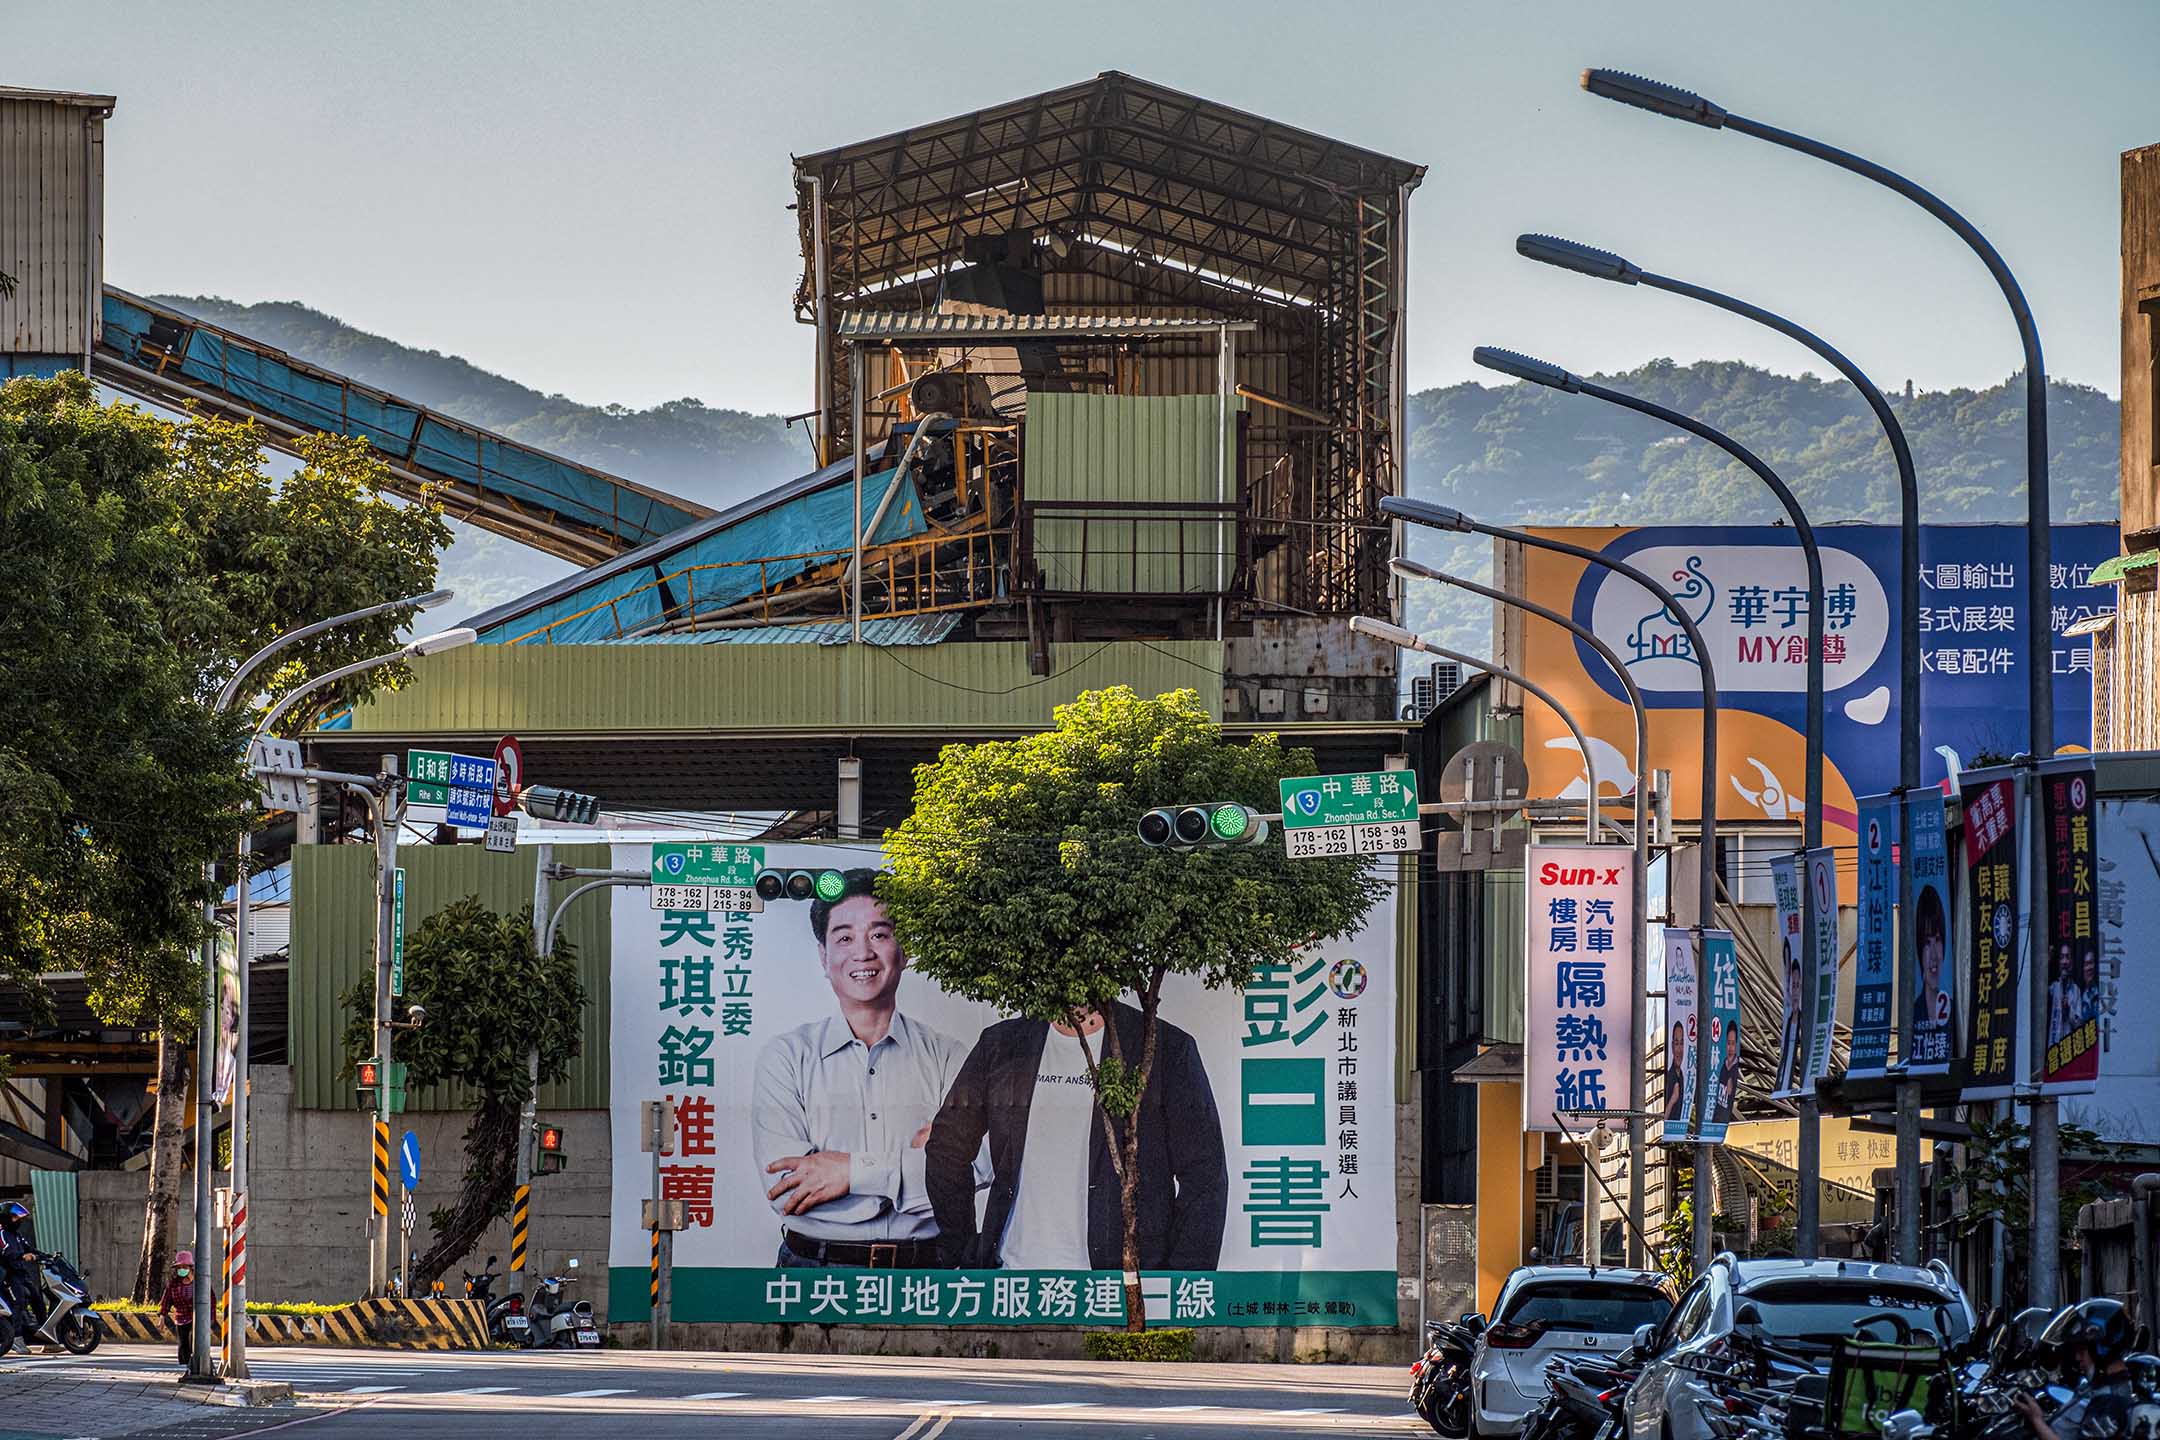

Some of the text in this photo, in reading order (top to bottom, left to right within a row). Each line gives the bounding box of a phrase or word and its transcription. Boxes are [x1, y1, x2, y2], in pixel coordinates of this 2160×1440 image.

[1728, 583, 1856, 629] 華宇博
[417, 756, 448, 782] 日和街
[451, 761, 493, 785] 多時相路口
[419, 789, 431, 801] Rihe
[1322, 773, 1400, 800] 中華路
[2073, 782, 2084, 805] 3
[1305, 794, 1315, 808] 3
[1324, 808, 1406, 824] Zhonghua Rd. Sec. 1
[1869, 824, 1879, 849] 2
[671, 857, 679, 869] 3
[687, 844, 752, 864] 中華路
[685, 874, 719, 886] Zhonghua
[720, 874, 731, 884] Rd.
[733, 875, 747, 885] Sec.
[1539, 862, 1621, 886] Sun-x
[2071, 815, 2092, 940] 黃永昌
[1817, 871, 1828, 905] 1
[1549, 897, 1578, 953] 樓房
[1585, 898, 1614, 954] 汽車
[1868, 858, 1883, 974] 江怡臻
[1973, 865, 1993, 1077] 侯友宜好做事
[1938, 993, 1948, 1020] 2
[1990, 952, 2010, 1074] 多一席
[1555, 961, 1607, 1111] 隔熱紙
[1688, 1018, 1697, 1038] 2
[1912, 1031, 1948, 1061] 江怡臻
[1241, 955, 1331, 1248] 彭一書
[1337, 1006, 1359, 1200] 新北市議員候選人
[1837, 1137, 1891, 1161] 專業 快速
[765, 1274, 1216, 1320] 中央到地方服務連一線
